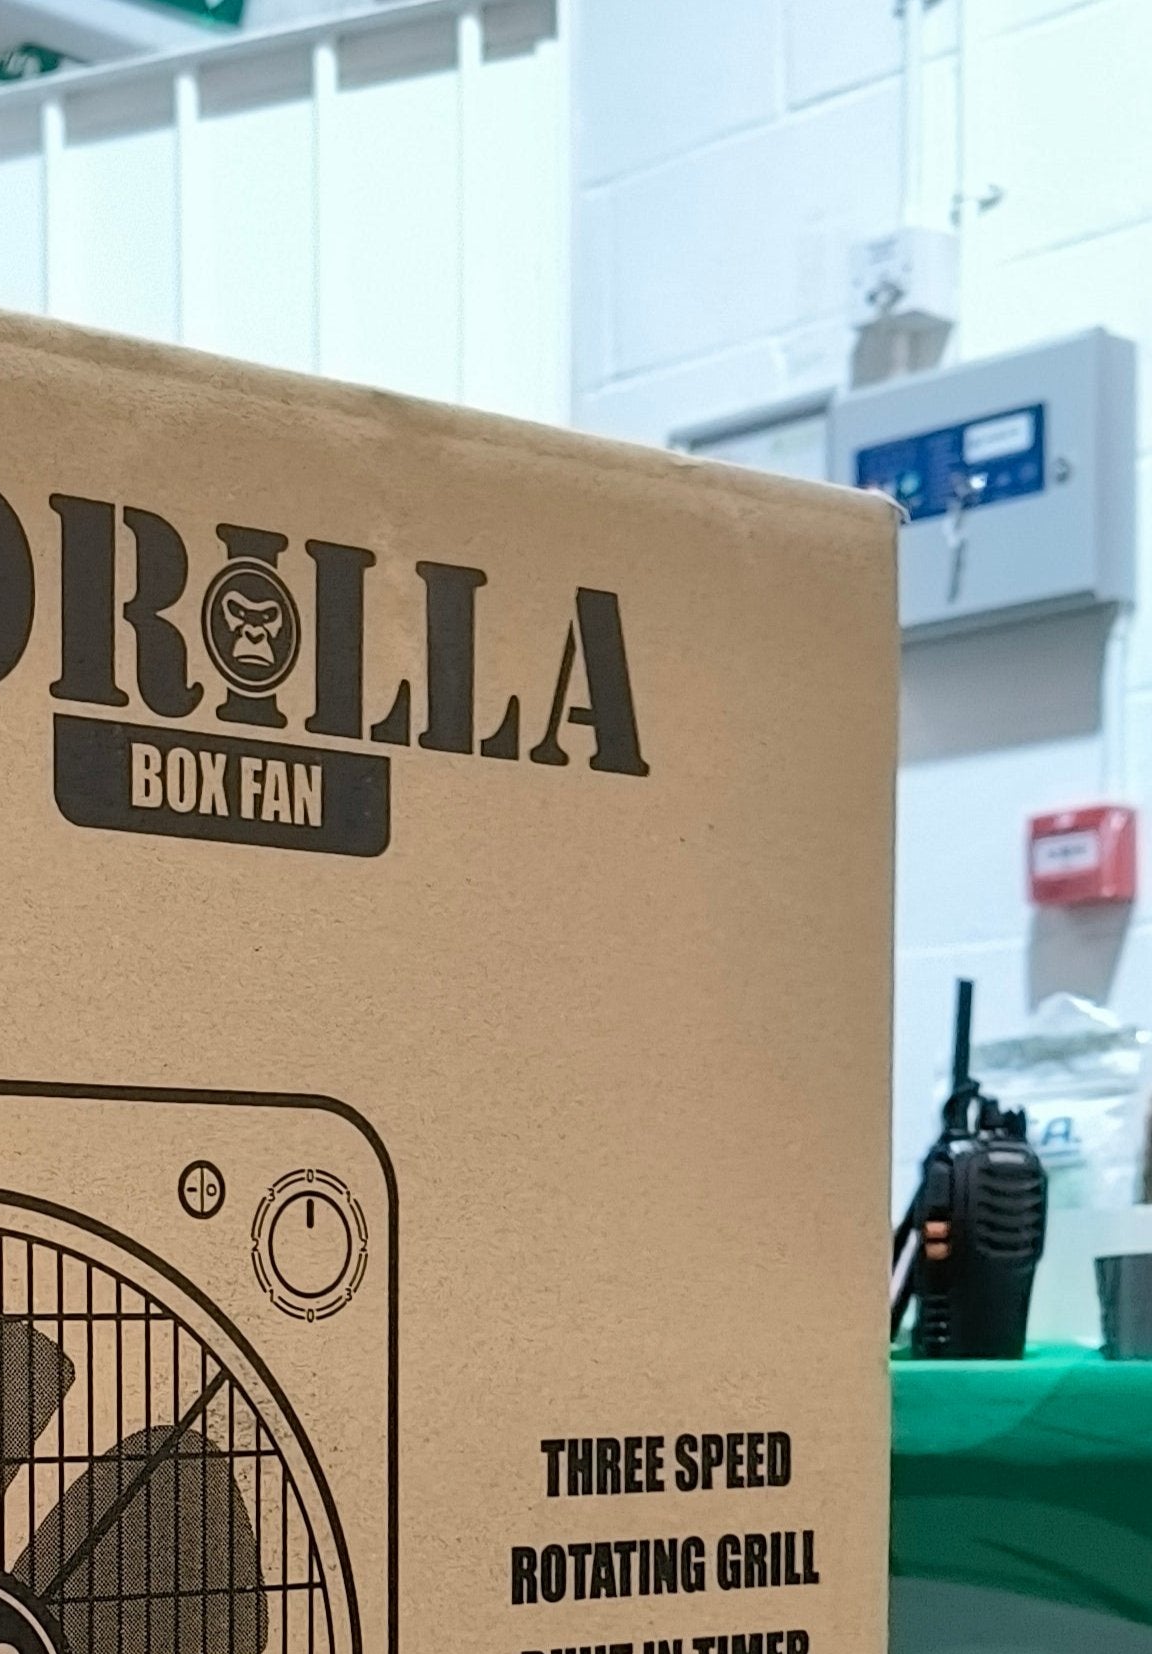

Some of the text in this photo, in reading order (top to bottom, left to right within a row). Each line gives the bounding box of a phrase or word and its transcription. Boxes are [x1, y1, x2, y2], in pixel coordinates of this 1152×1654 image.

[131, 742, 323, 827] BOX FAN
[306, 1169, 314, 1183] 0
[266, 1188, 276, 1202] 3
[251, 1238, 259, 1252] 2
[344, 1288, 353, 1302] 3
[306, 1308, 315, 1323] 0
[540, 1431, 791, 1498] THREE SPEED
[511, 1529, 820, 1605] ROTATING GRILL
